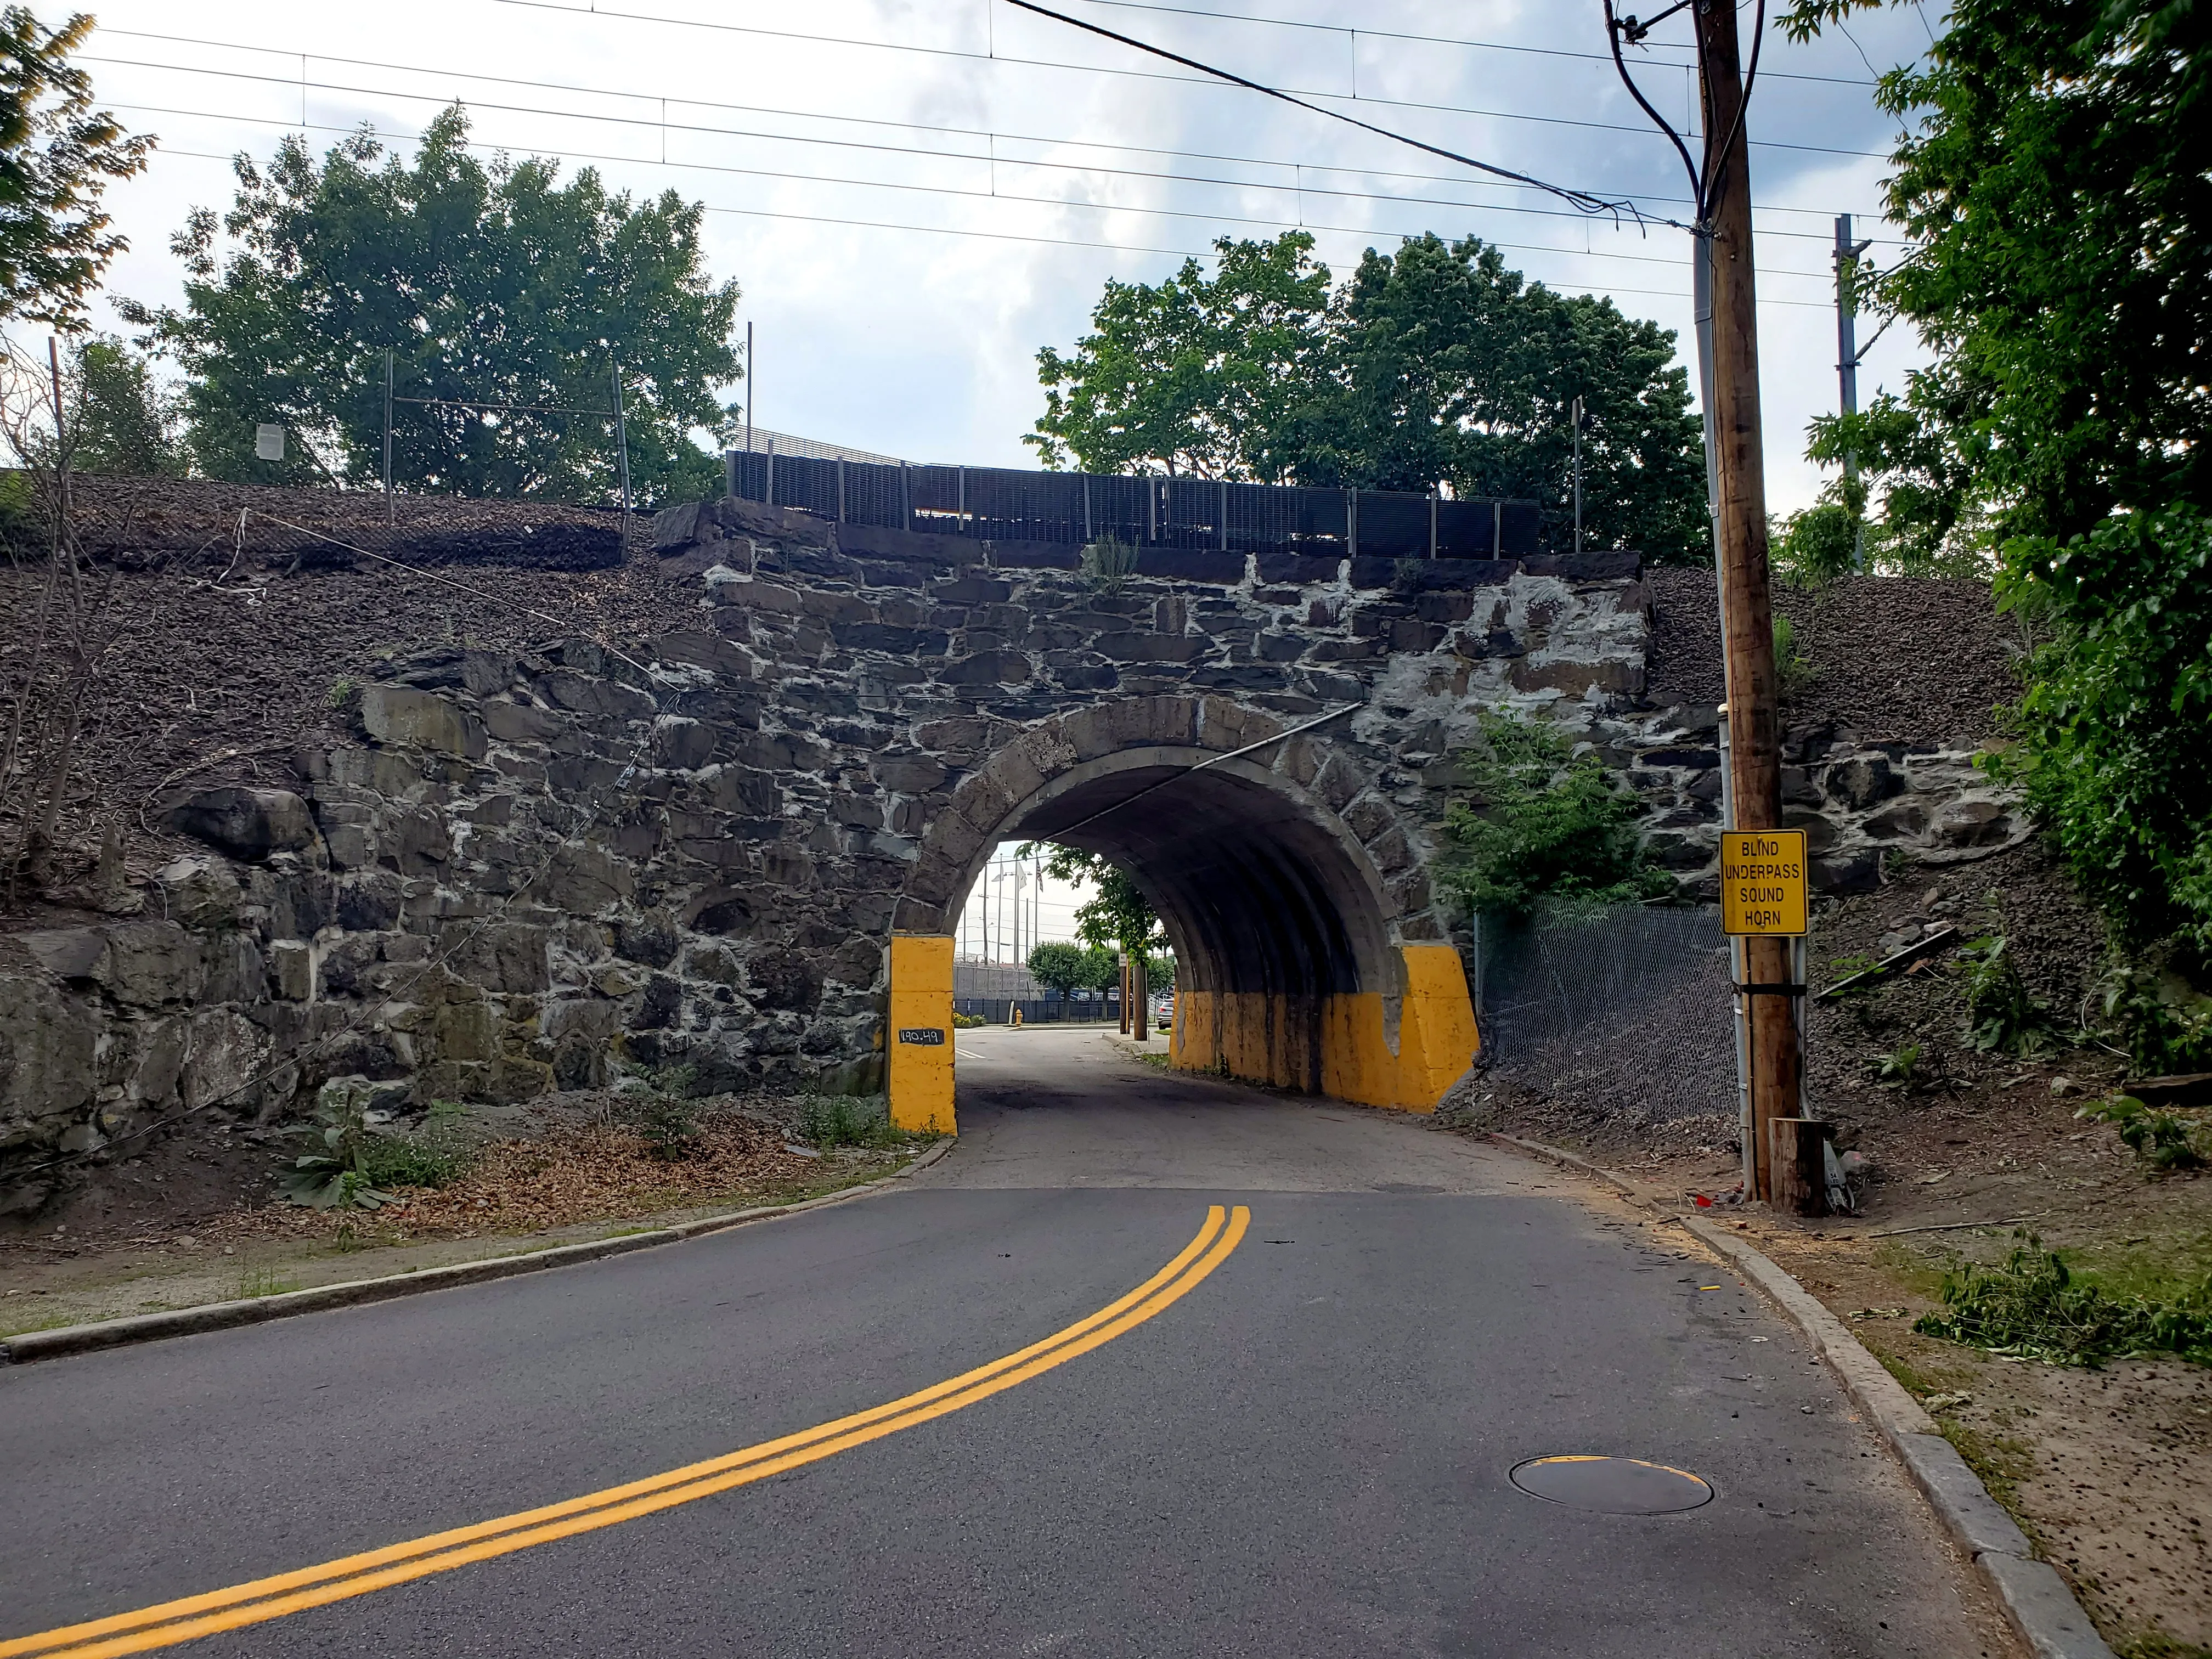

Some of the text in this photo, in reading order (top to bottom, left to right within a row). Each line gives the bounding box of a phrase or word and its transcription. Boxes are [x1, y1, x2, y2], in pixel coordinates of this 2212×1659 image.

[1742, 841, 1779, 856] BLIND
[1725, 864, 1799, 880] UNDERPASS
[1740, 887, 1784, 902] SOUND
[1745, 910, 1781, 926] HORN
